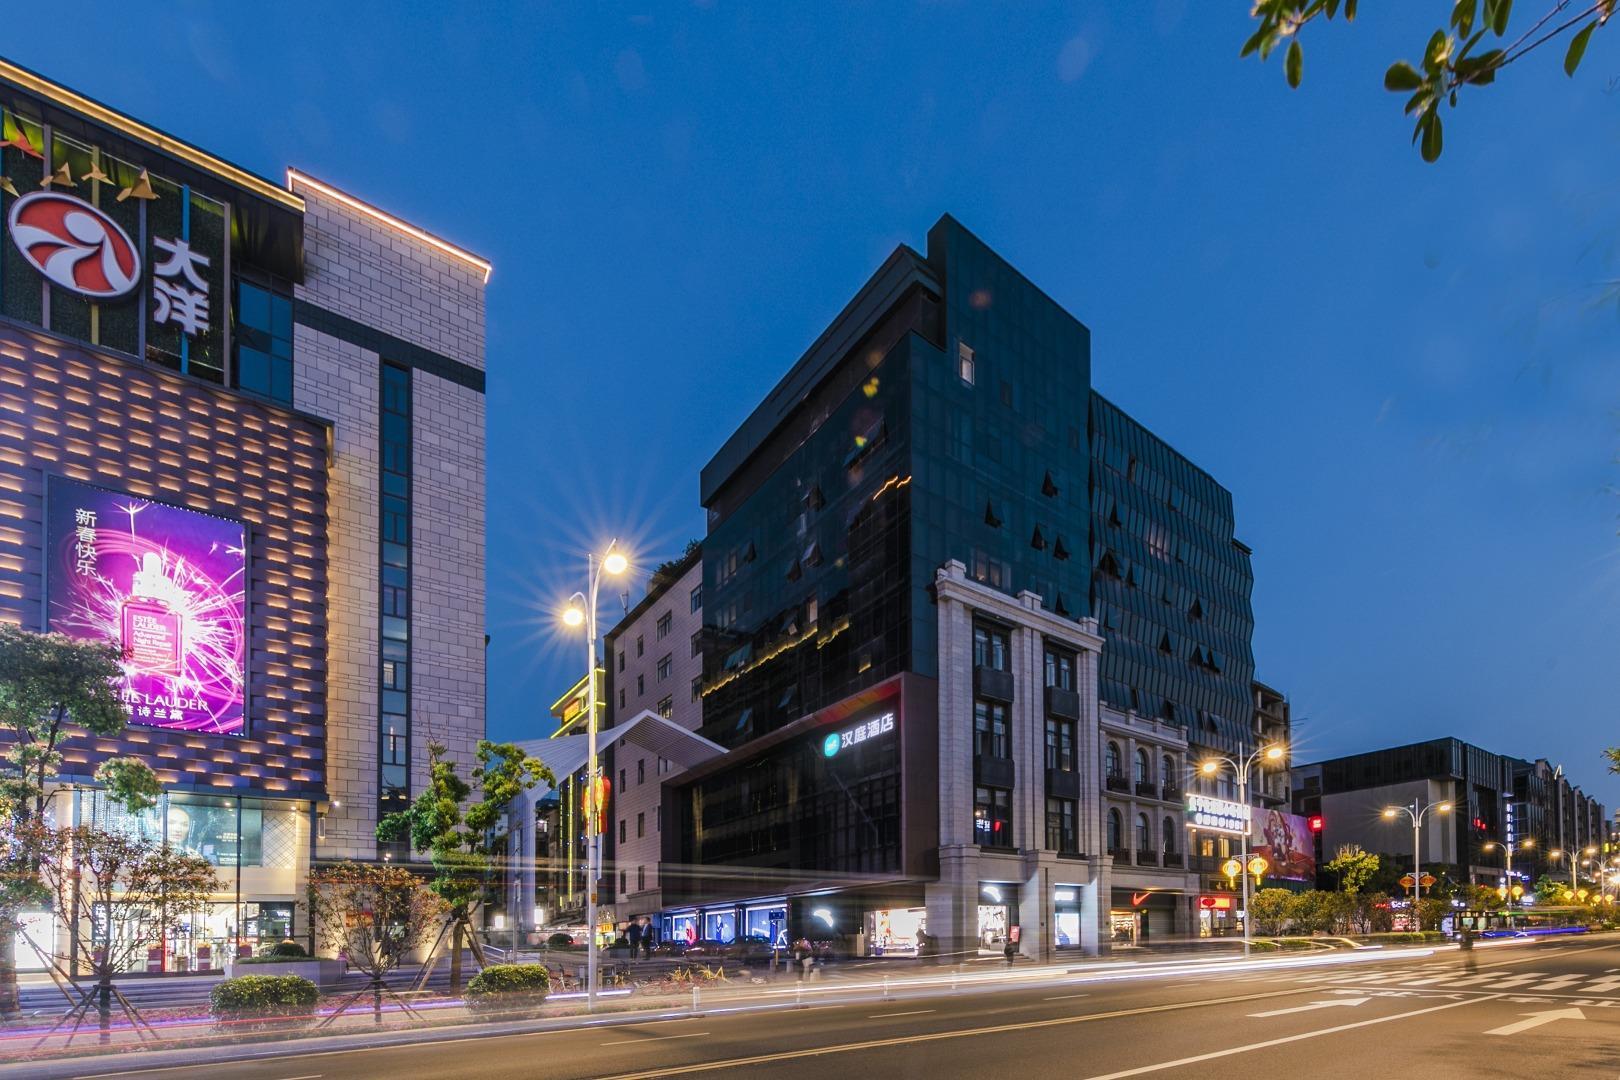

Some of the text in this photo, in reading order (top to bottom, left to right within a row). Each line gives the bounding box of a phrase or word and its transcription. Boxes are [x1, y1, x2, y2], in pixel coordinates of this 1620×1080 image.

[153, 235, 209, 335] 大洋
[75, 508, 97, 577] 新春快乐
[145, 693, 208, 711] LAUDER
[841, 713, 894, 748] 汉庭酒店
